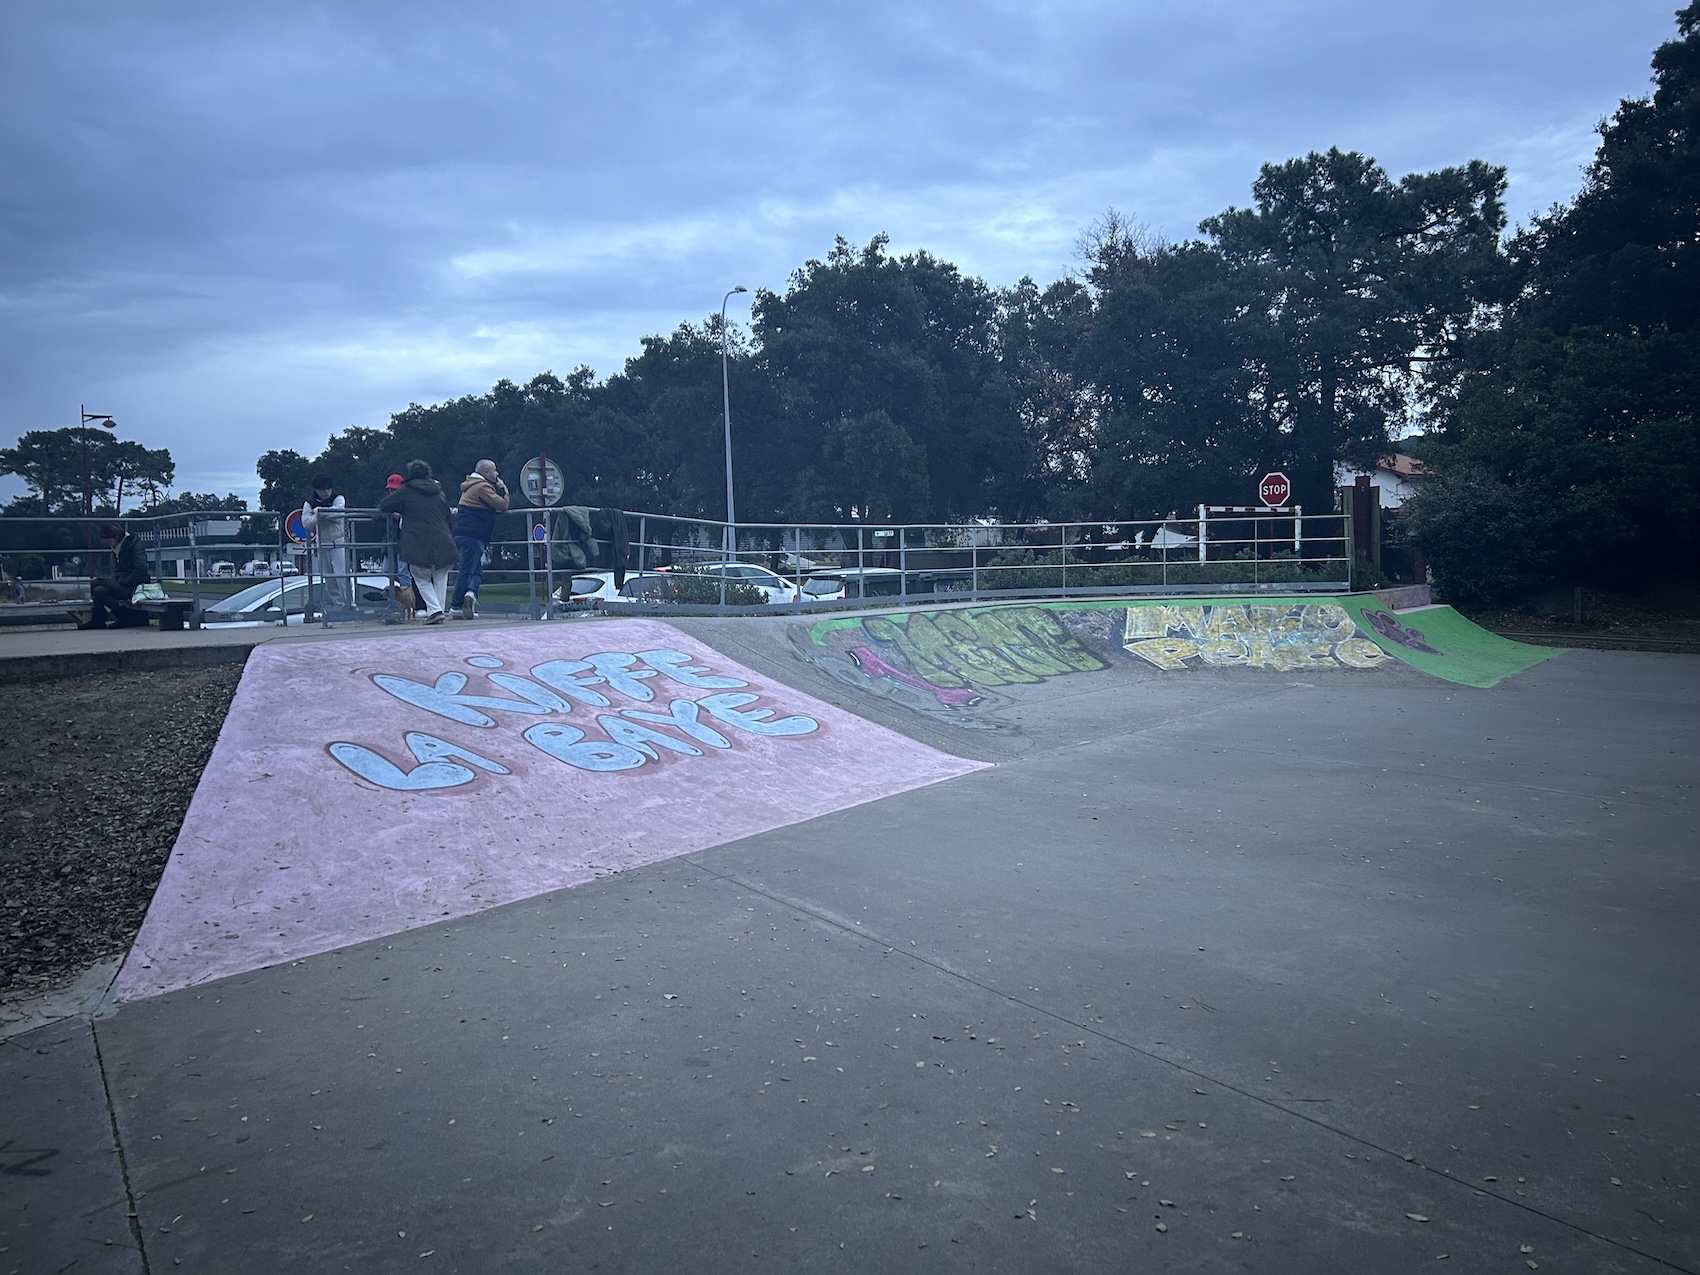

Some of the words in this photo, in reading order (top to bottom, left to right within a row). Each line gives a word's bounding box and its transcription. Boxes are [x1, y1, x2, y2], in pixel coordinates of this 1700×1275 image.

[1262, 484, 1287, 496] STOP
[324, 730, 513, 791] LA
[521, 691, 819, 772] BAYE
